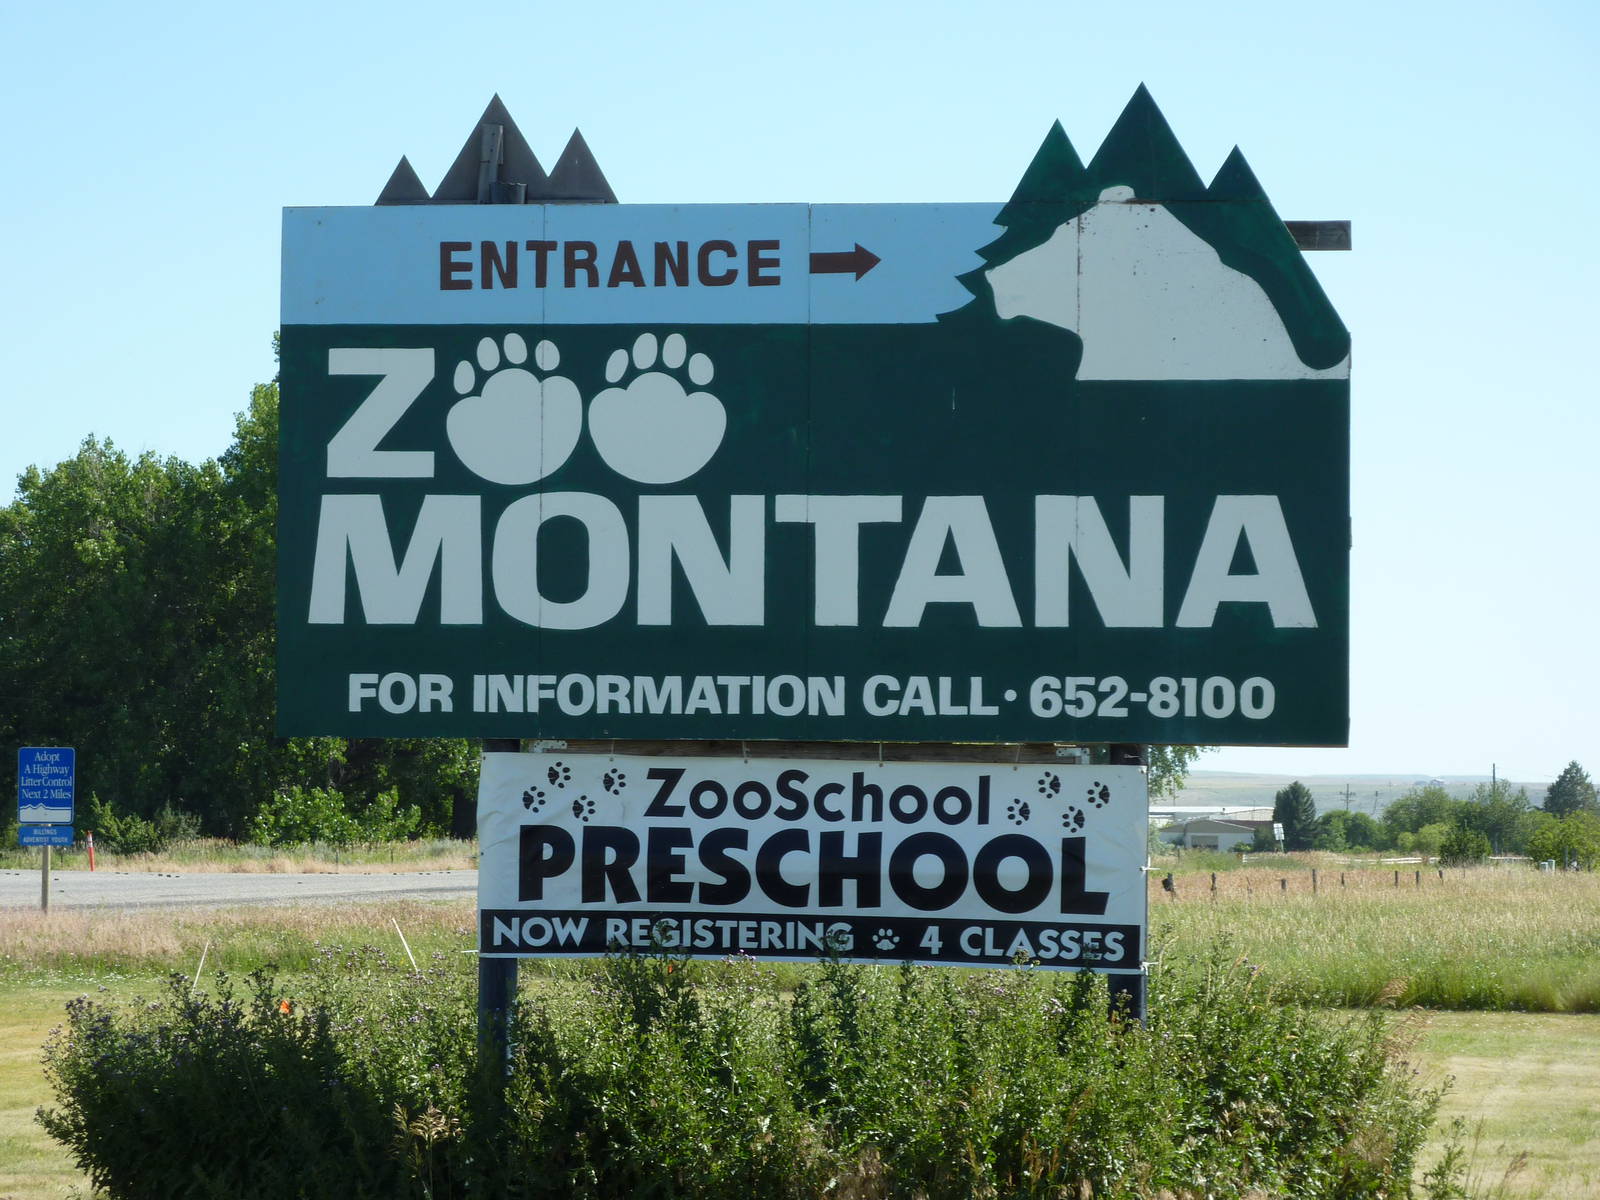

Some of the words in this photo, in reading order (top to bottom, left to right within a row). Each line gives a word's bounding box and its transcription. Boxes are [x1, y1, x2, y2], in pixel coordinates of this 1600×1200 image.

[440, 240, 780, 290] ENTRANCE
[307, 492, 1319, 630] MONTANA
[347, 673, 454, 714] FOR
[472, 673, 847, 717] INFORMATION
[862, 675, 999, 718] CALL
[1029, 676, 1277, 720] 652-8100
[24, 764, 31, 774] A
[33, 763, 70, 777] Highway
[34, 751, 60, 763] Adopt
[21, 776, 41, 787] Litter
[42, 776, 73, 787] Control
[22, 788, 41, 799] Next
[43, 788, 49, 799] 2
[50, 788, 72, 799] Miles
[646, 768, 990, 826] ZooSchool
[519, 825, 1110, 917] PRESCHOOL
[493, 917, 588, 947] NOW
[606, 918, 854, 952] REGISTERING
[919, 925, 943, 955] 4
[959, 926, 1126, 962] CLASSES
